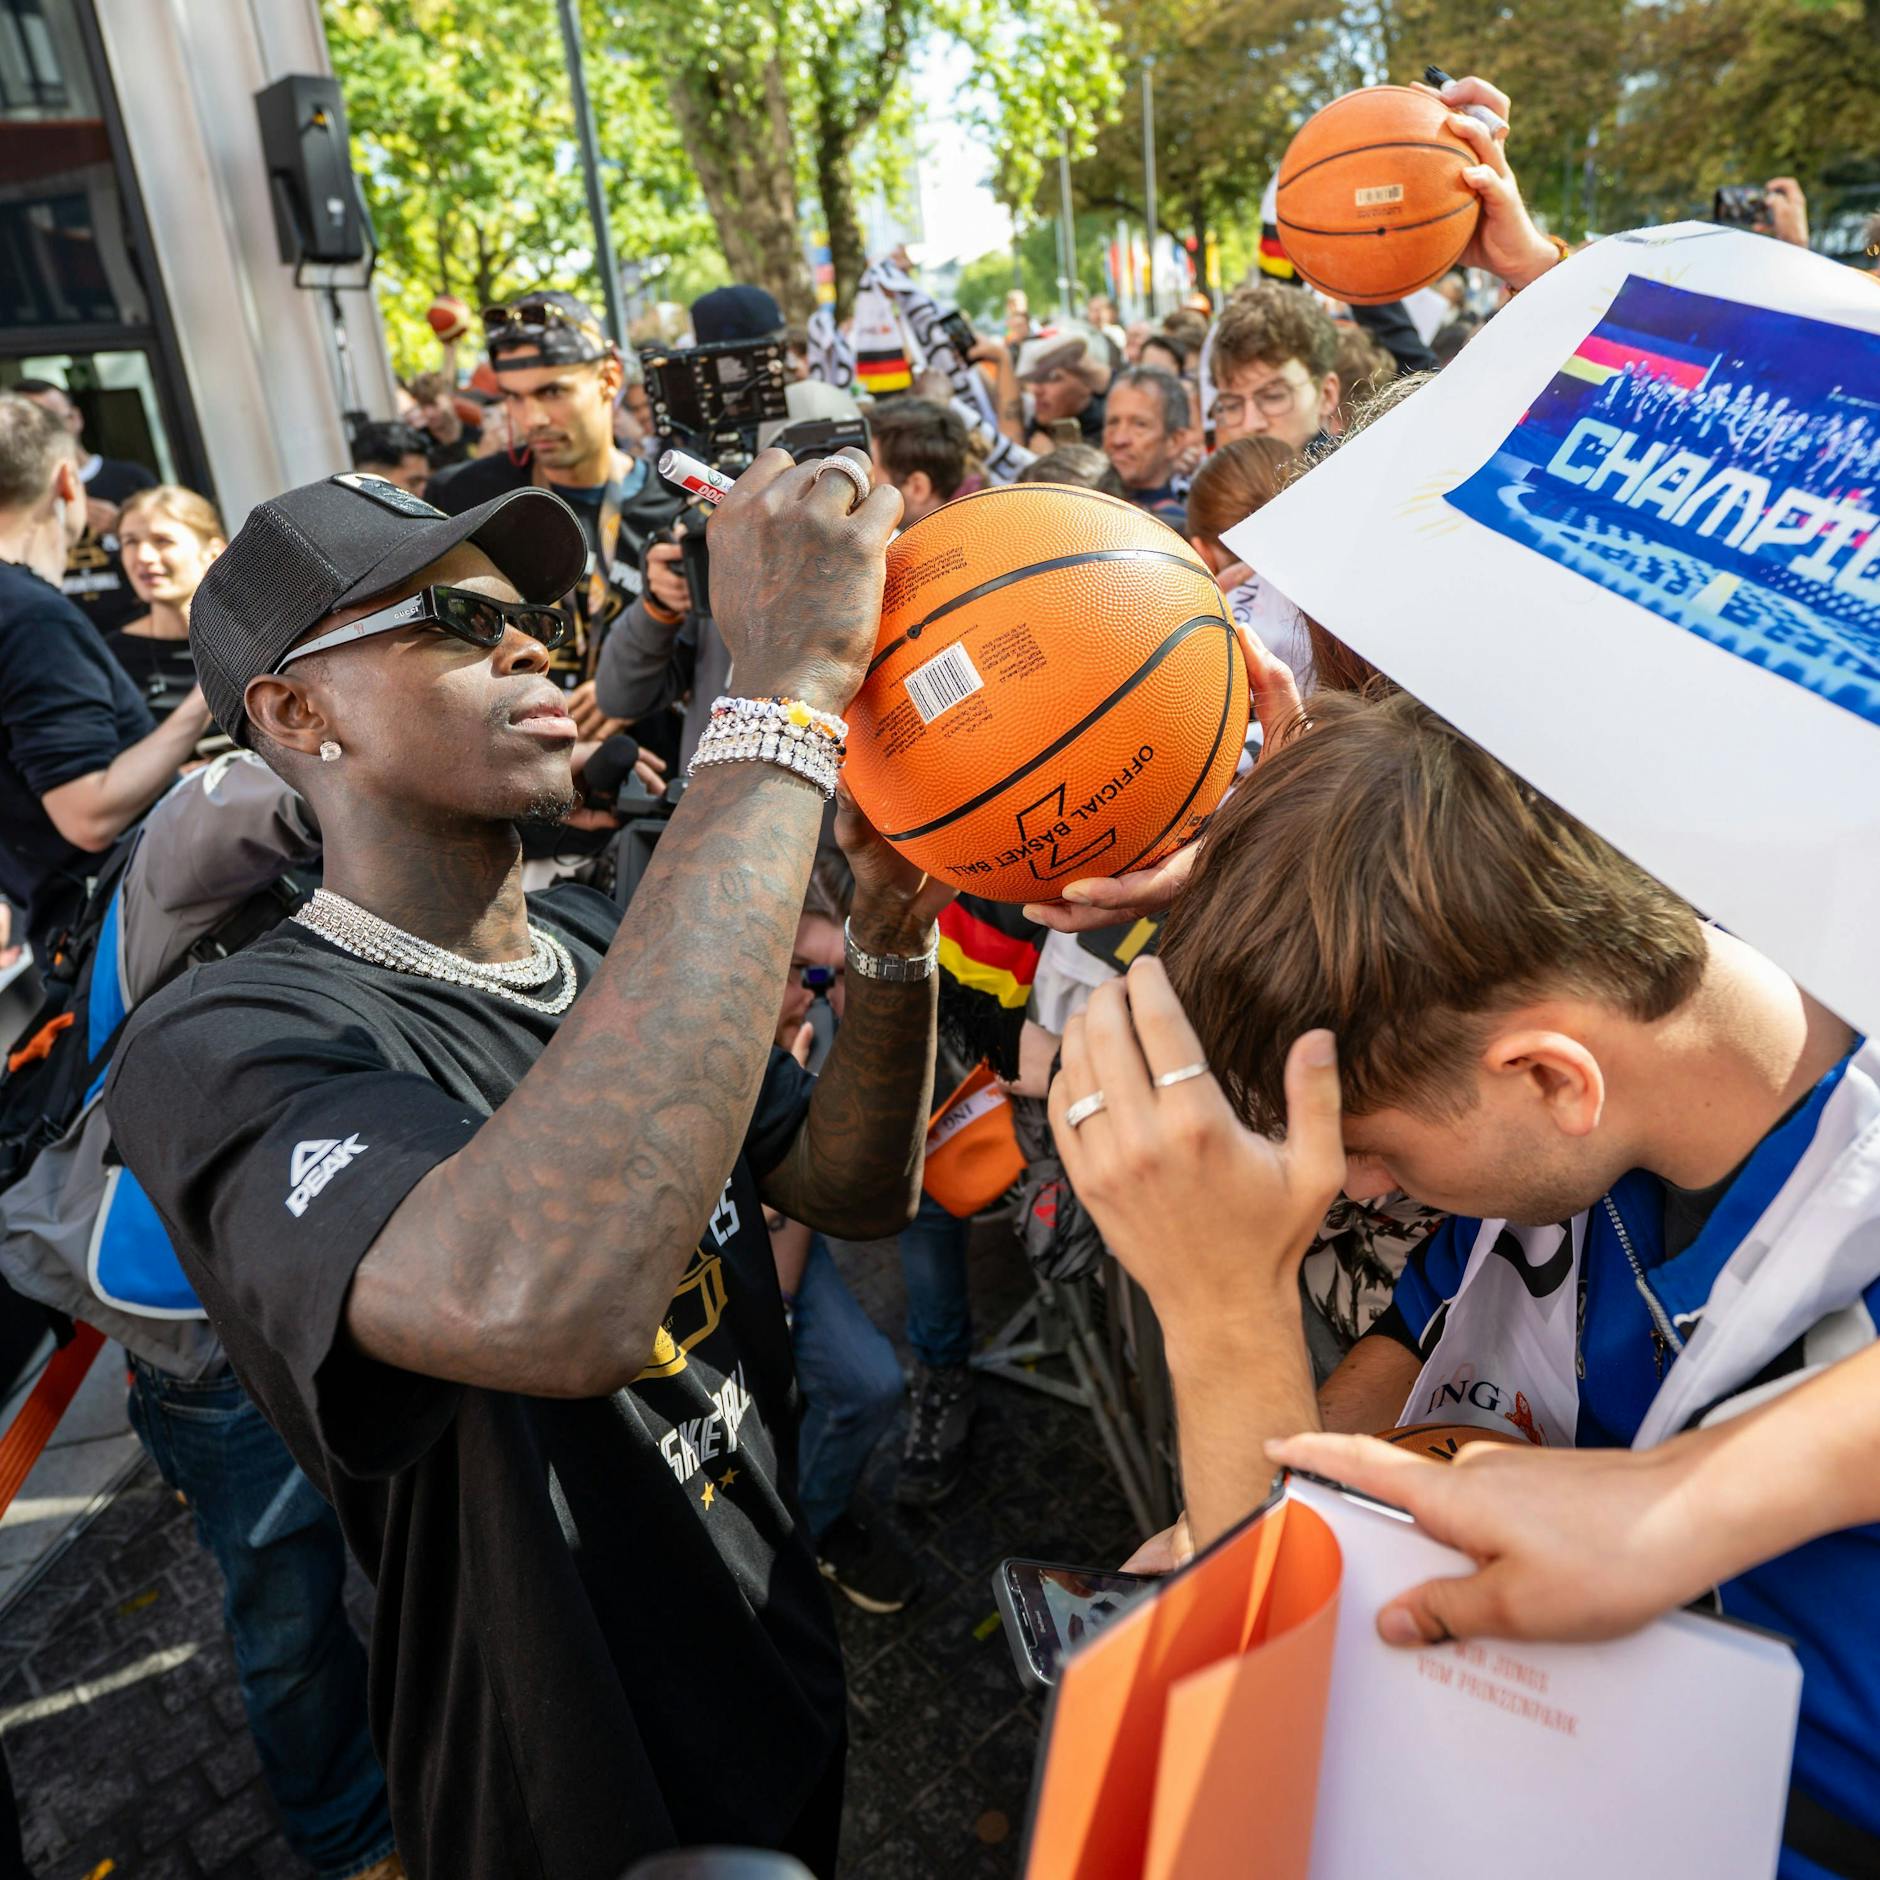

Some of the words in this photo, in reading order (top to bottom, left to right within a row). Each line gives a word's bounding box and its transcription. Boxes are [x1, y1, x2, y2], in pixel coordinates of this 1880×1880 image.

[394, 606, 418, 619] GUCCI
[729, 699, 773, 714] NILA
[1071, 745, 1154, 820] OFFICIAL
[995, 821, 1072, 866] BASKET
[945, 860, 993, 877] BALL
[285, 1132, 369, 1217] PEAK
[1426, 1380, 1501, 1416] ING
